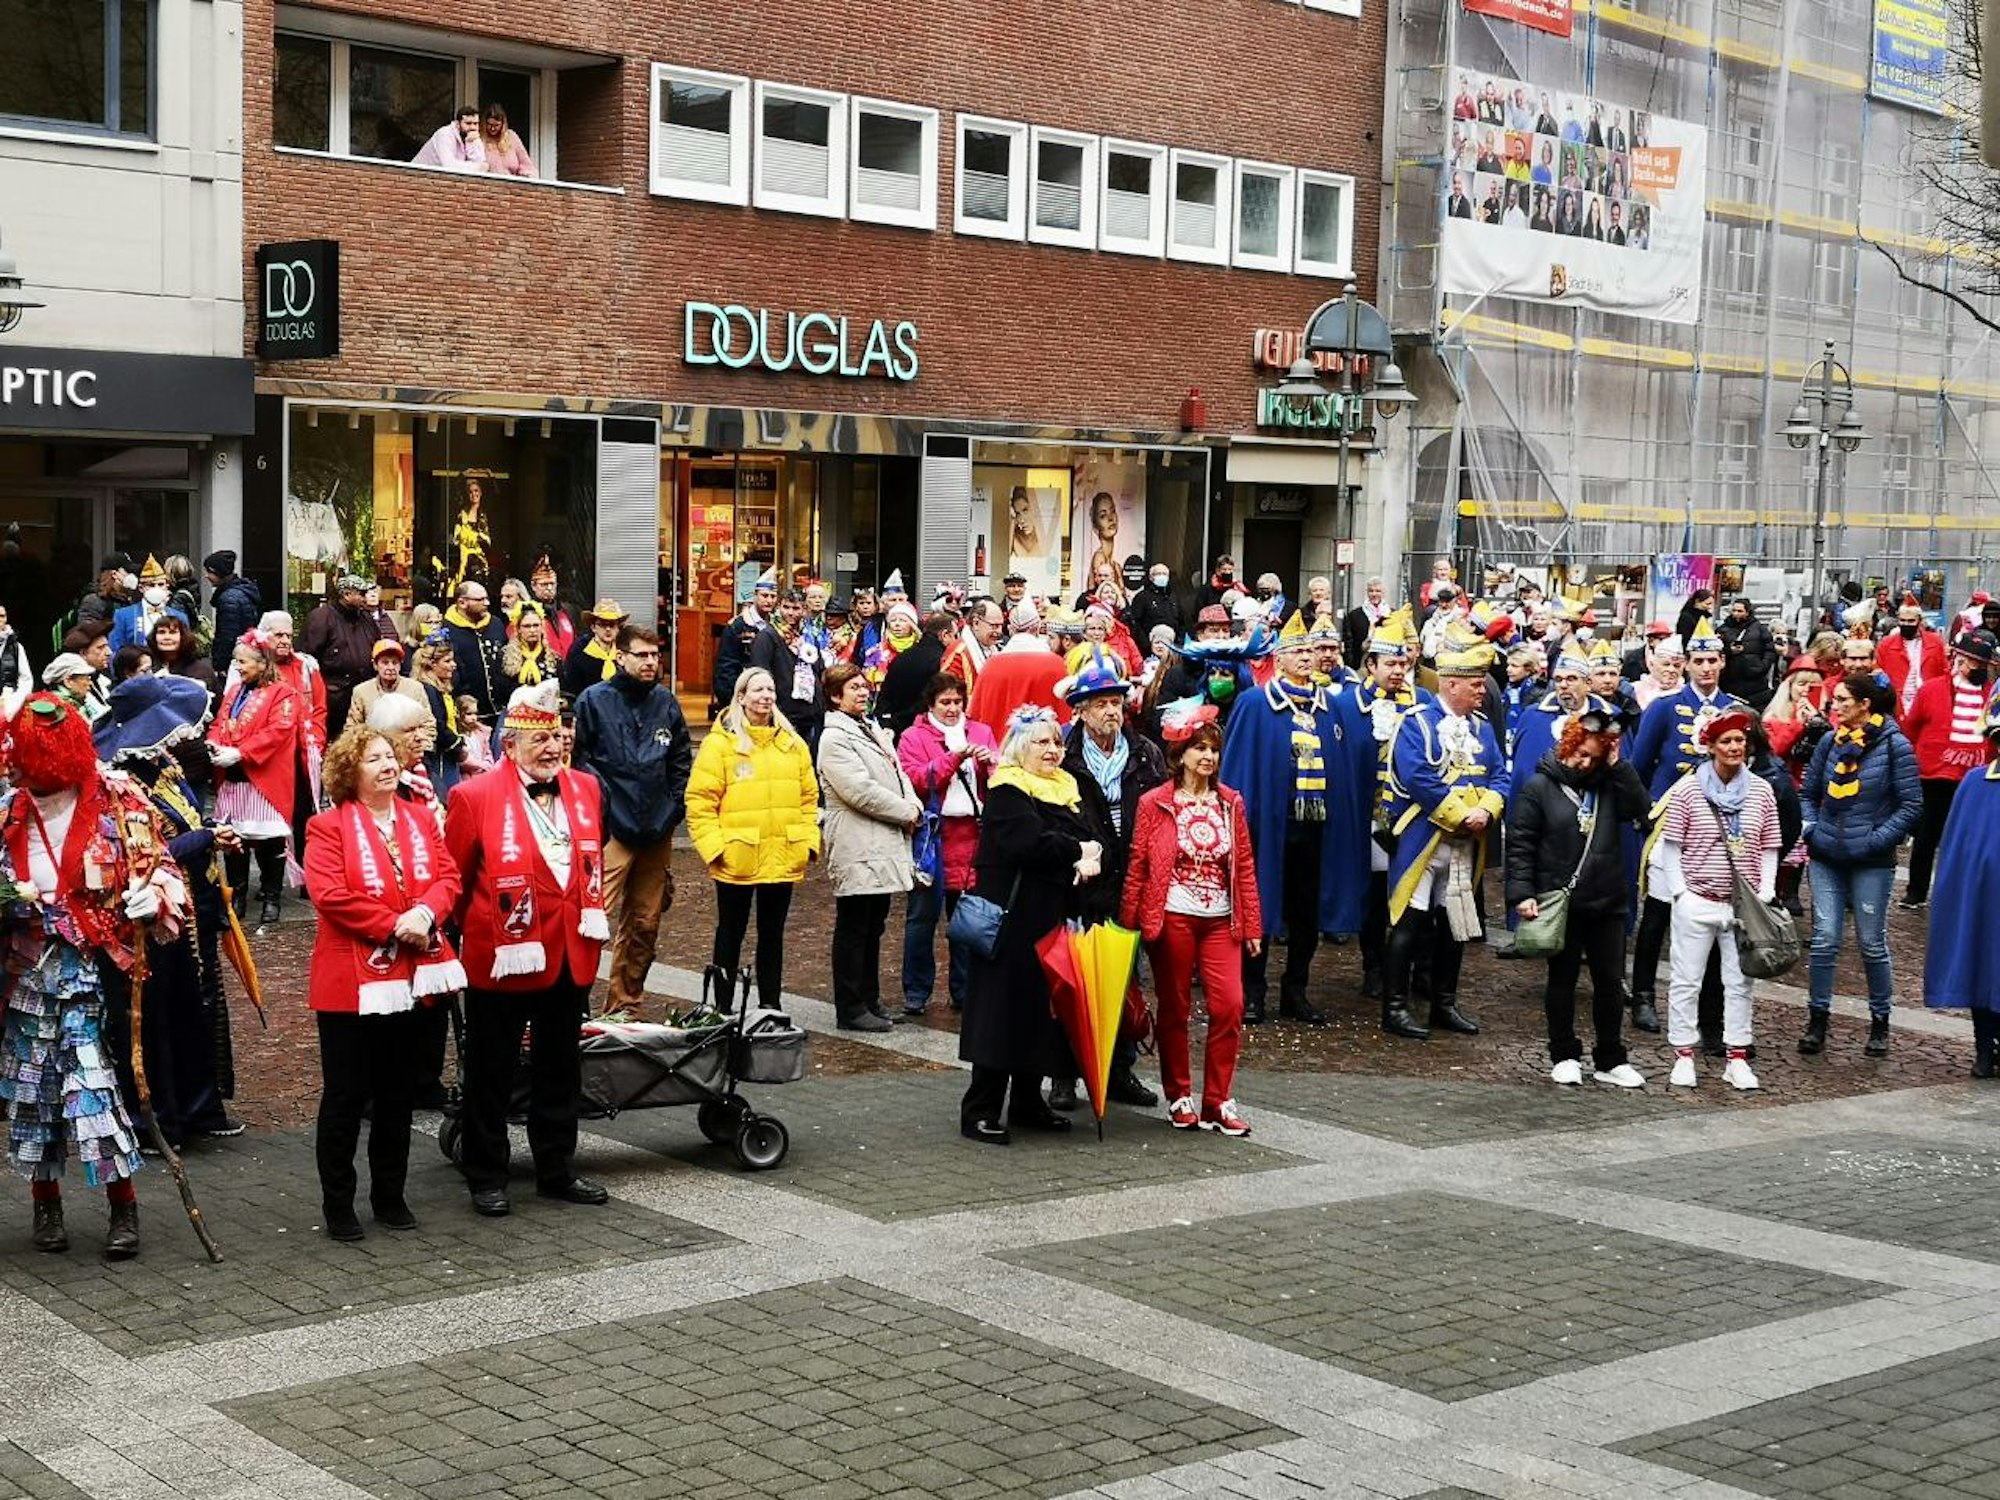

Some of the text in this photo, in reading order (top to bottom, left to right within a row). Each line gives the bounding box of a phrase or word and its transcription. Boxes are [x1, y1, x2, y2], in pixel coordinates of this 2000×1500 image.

[265, 321, 316, 342] DOUGLAS
[684, 300, 920, 381] DOUGLAS
[2, 366, 97, 408] PTIC
[256, 454, 267, 470] 6
